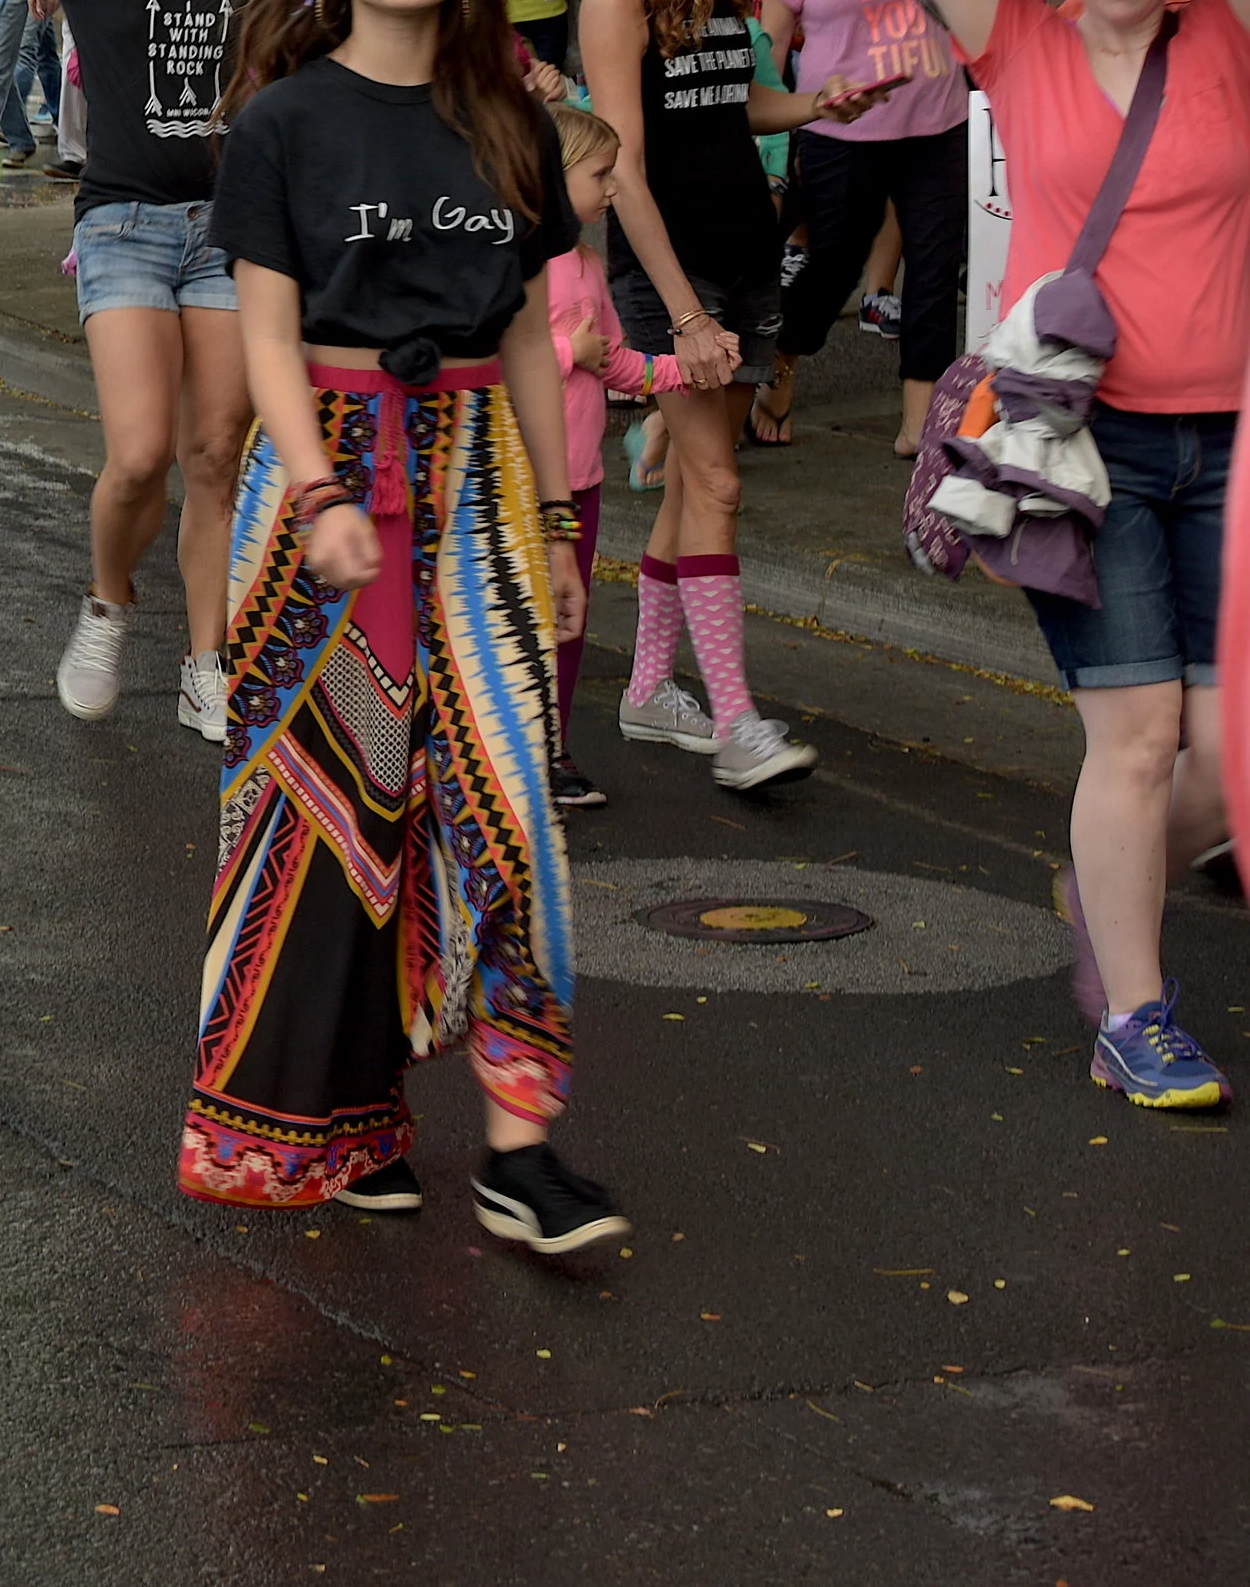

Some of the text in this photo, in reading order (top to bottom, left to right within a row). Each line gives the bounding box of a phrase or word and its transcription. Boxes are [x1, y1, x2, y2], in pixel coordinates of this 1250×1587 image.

[163, 12, 217, 28] STAND
[169, 27, 209, 43] WITH
[148, 43, 224, 60] STANDING
[166, 60, 204, 76] ROCK
[664, 54, 699, 78] SAVE
[664, 87, 699, 110] SAVE
[344, 196, 515, 245] I'm Gay
